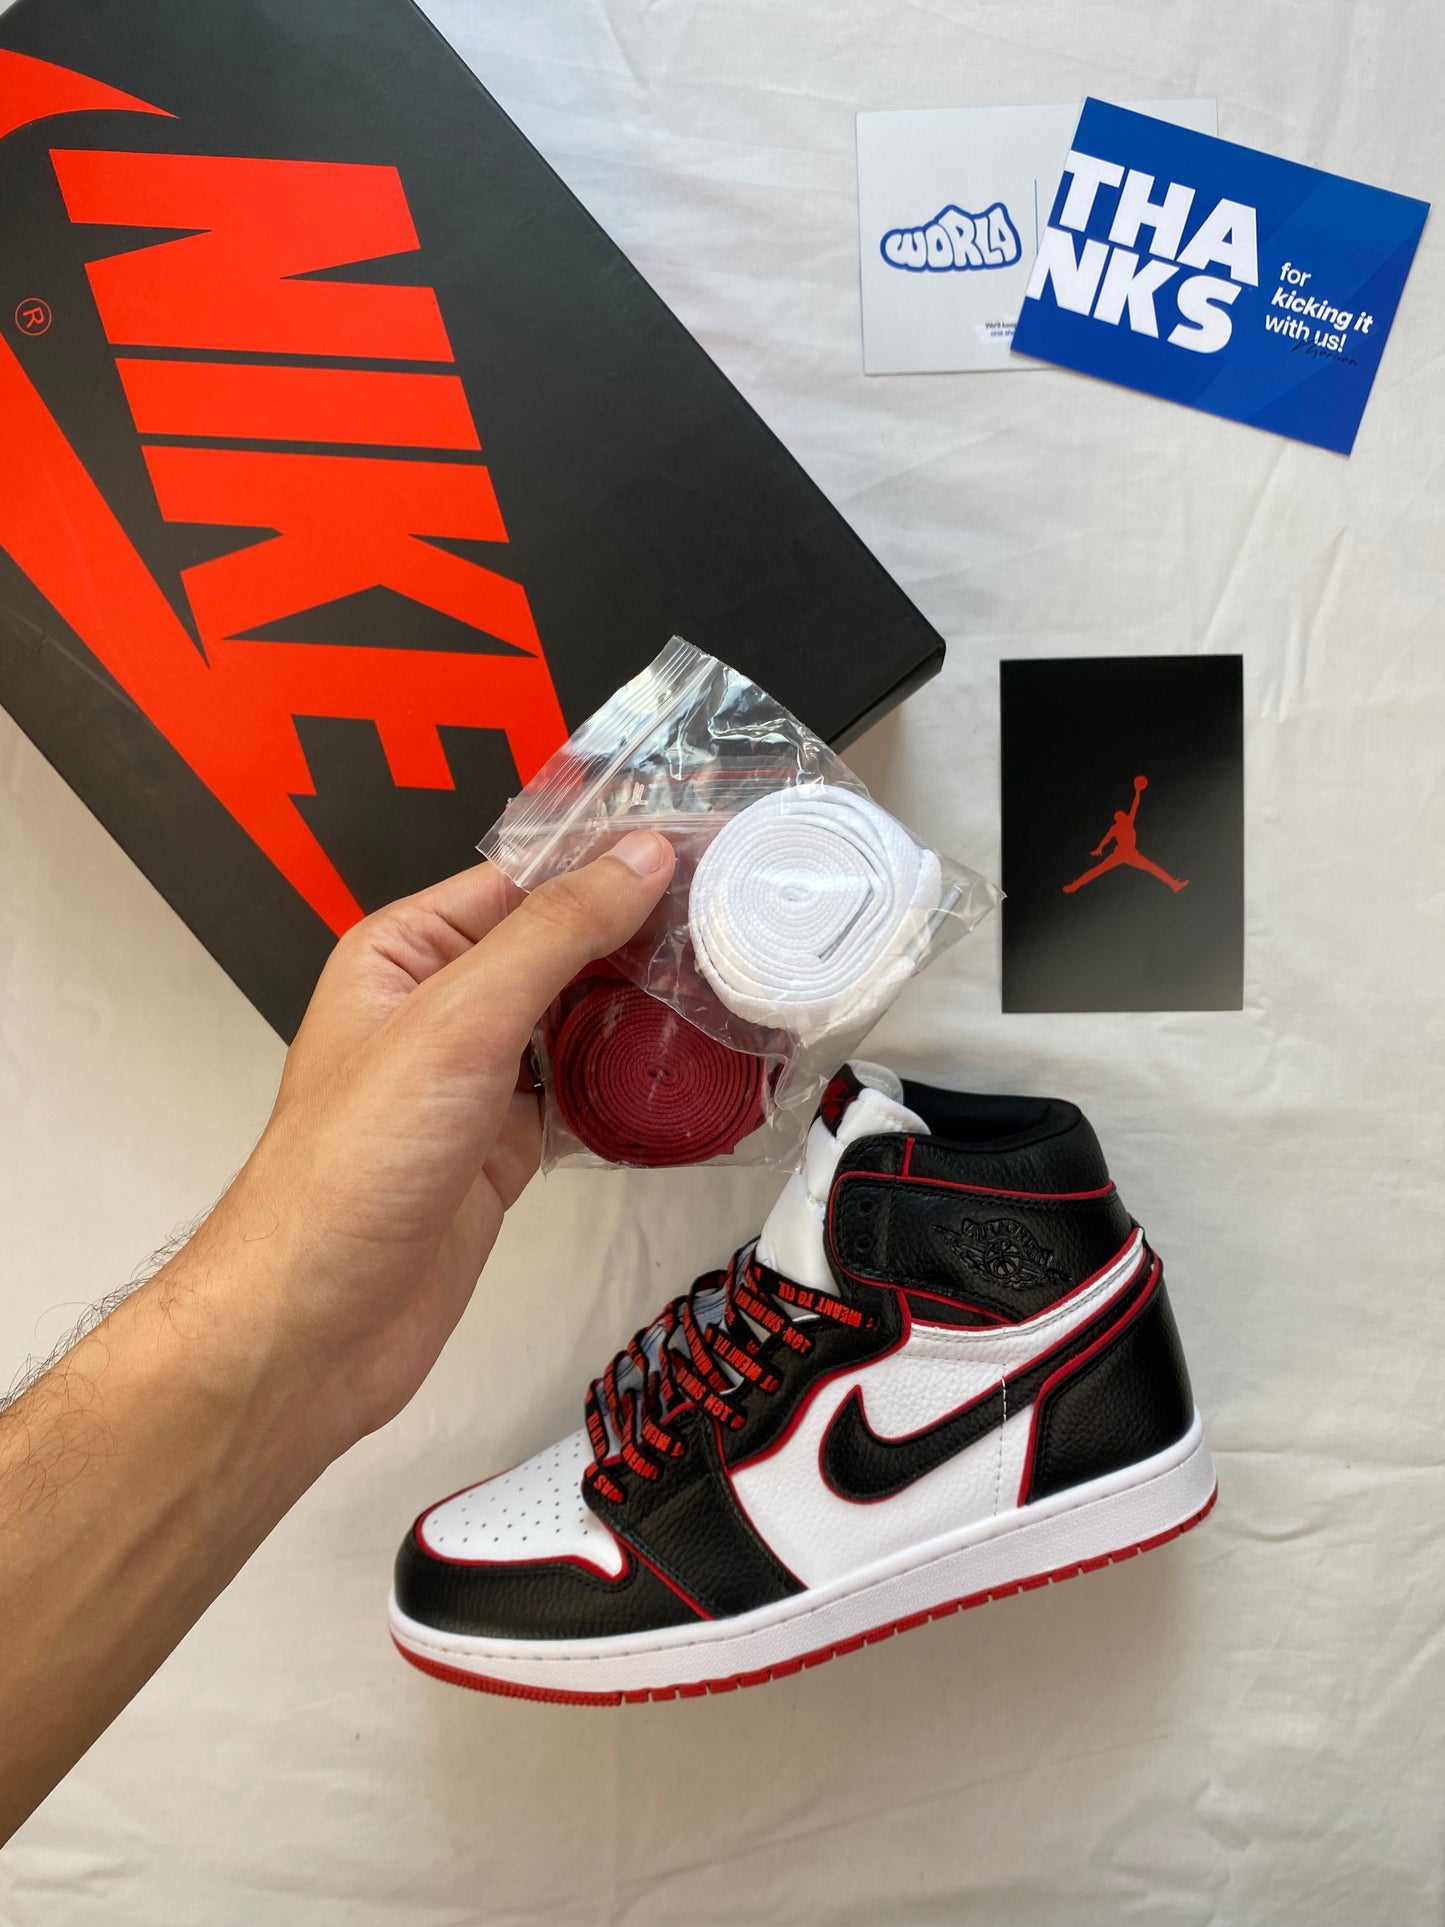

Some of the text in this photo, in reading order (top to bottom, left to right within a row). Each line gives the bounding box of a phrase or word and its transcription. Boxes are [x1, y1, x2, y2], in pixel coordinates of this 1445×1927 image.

[1058, 150, 1259, 287] THA
[1025, 226, 1242, 354] NKS
[1280, 262, 1311, 287] for
[1271, 287, 1373, 334] kicking it
[1265, 315, 1347, 353] with us!
[49, 149, 584, 805] NIKE
[798, 1291, 815, 1309] TO
[814, 1297, 863, 1328] MEANT
[782, 1326, 813, 1355] NOT
[726, 1348, 763, 1384] MEANT
[703, 1394, 733, 1422] NOT
[593, 1474, 623, 1503] WAS
